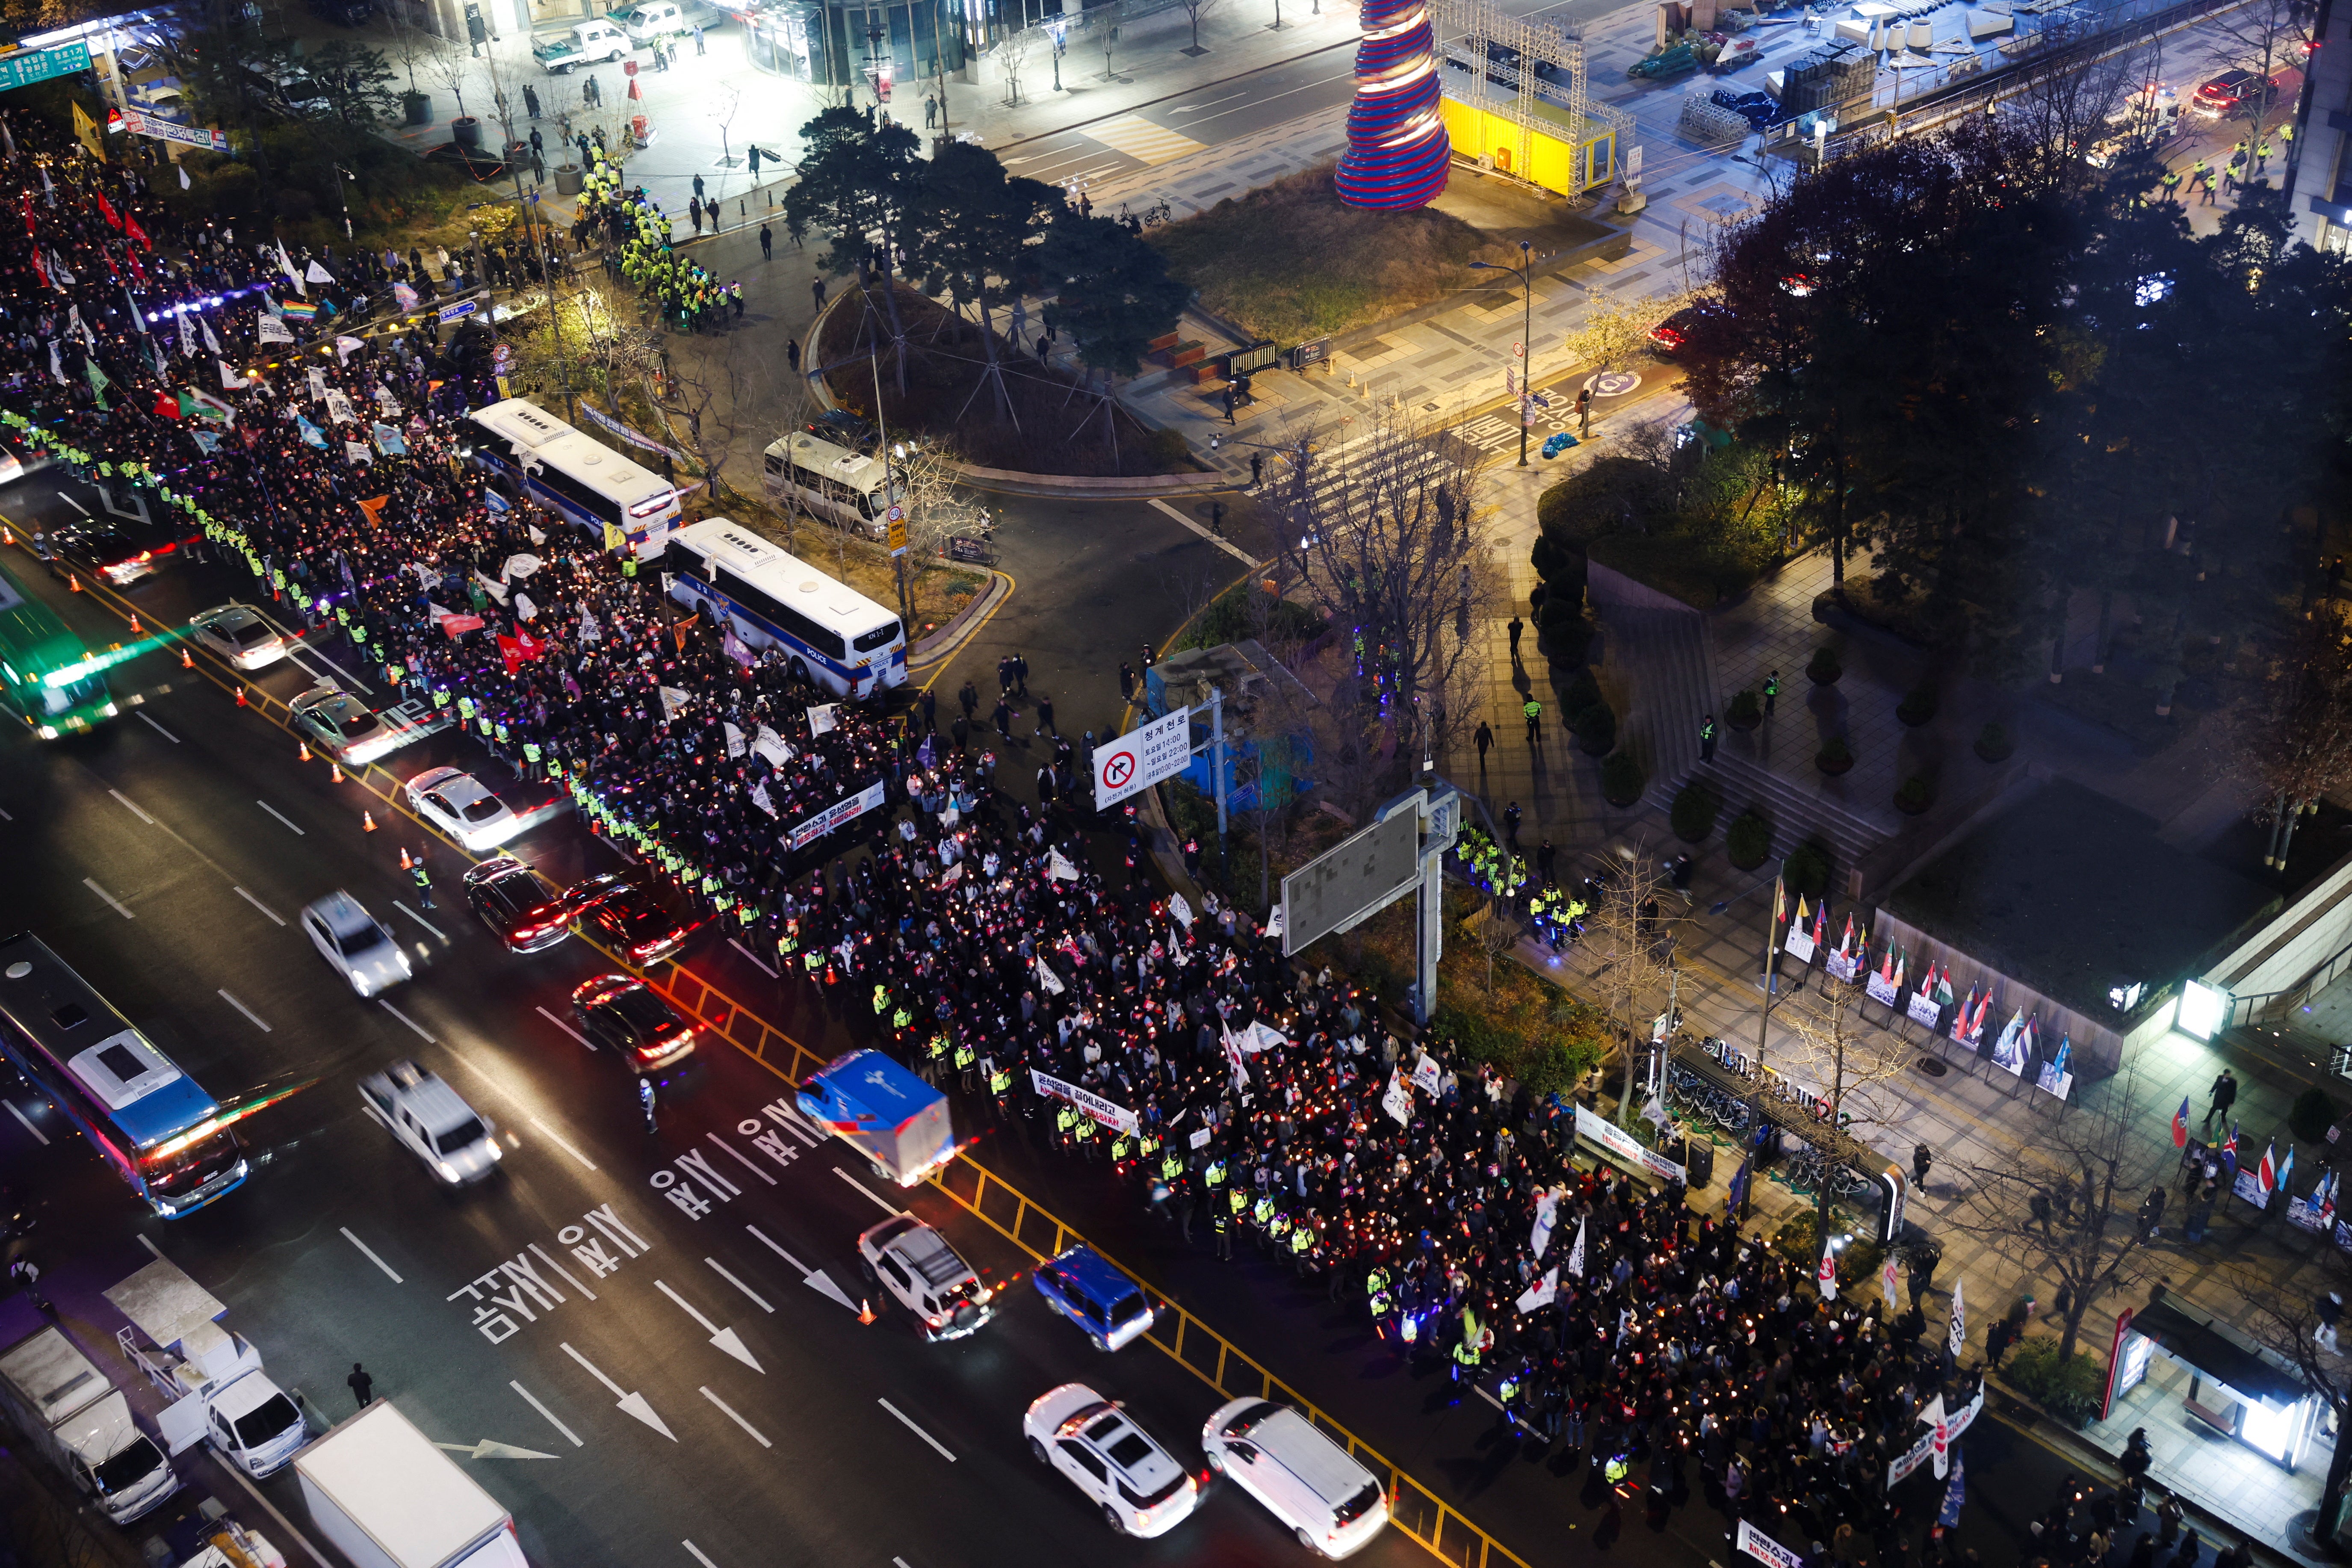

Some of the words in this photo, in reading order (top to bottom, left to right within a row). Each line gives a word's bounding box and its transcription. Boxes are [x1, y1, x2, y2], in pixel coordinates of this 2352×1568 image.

[23, 53, 46, 64] 독립문
[54, 47, 83, 60] 종로1가
[27, 62, 48, 73] 광화문
[494, 458, 504, 468] 경찰
[591, 515, 604, 528] POLIC
[890, 509, 899, 519] 50
[650, 525, 665, 534] POLICE
[891, 532, 904, 540] 단속중
[696, 582, 707, 594] 경찰
[807, 647, 827, 665] POLICE
[874, 659, 889, 669] POLICE
[1144, 715, 1186, 741] 청계천로
[1145, 742, 1161, 756] 토요일
[1162, 733, 1181, 748] 14:00
[1146, 752, 1167, 766] ~일요일
[1169, 742, 1188, 757] 22:00
[1105, 790, 1123, 803] (자전거
[1123, 783, 1136, 793] 허용)
[829, 796, 860, 819] 윤석열을
[796, 823, 826, 847] 체포하고
[828, 804, 862, 827] 처벌하라!
[1038, 1074, 1071, 1096] 윤석열을
[1075, 1089, 1116, 1116] 끌어내리고
[650, 1148, 742, 1221] 시청
[558, 1203, 651, 1279] 시청
[446, 1252, 567, 1345] 서소문
[1749, 1530, 1793, 1565] 반란수괴
[1749, 1542, 1788, 1568] 체포하
